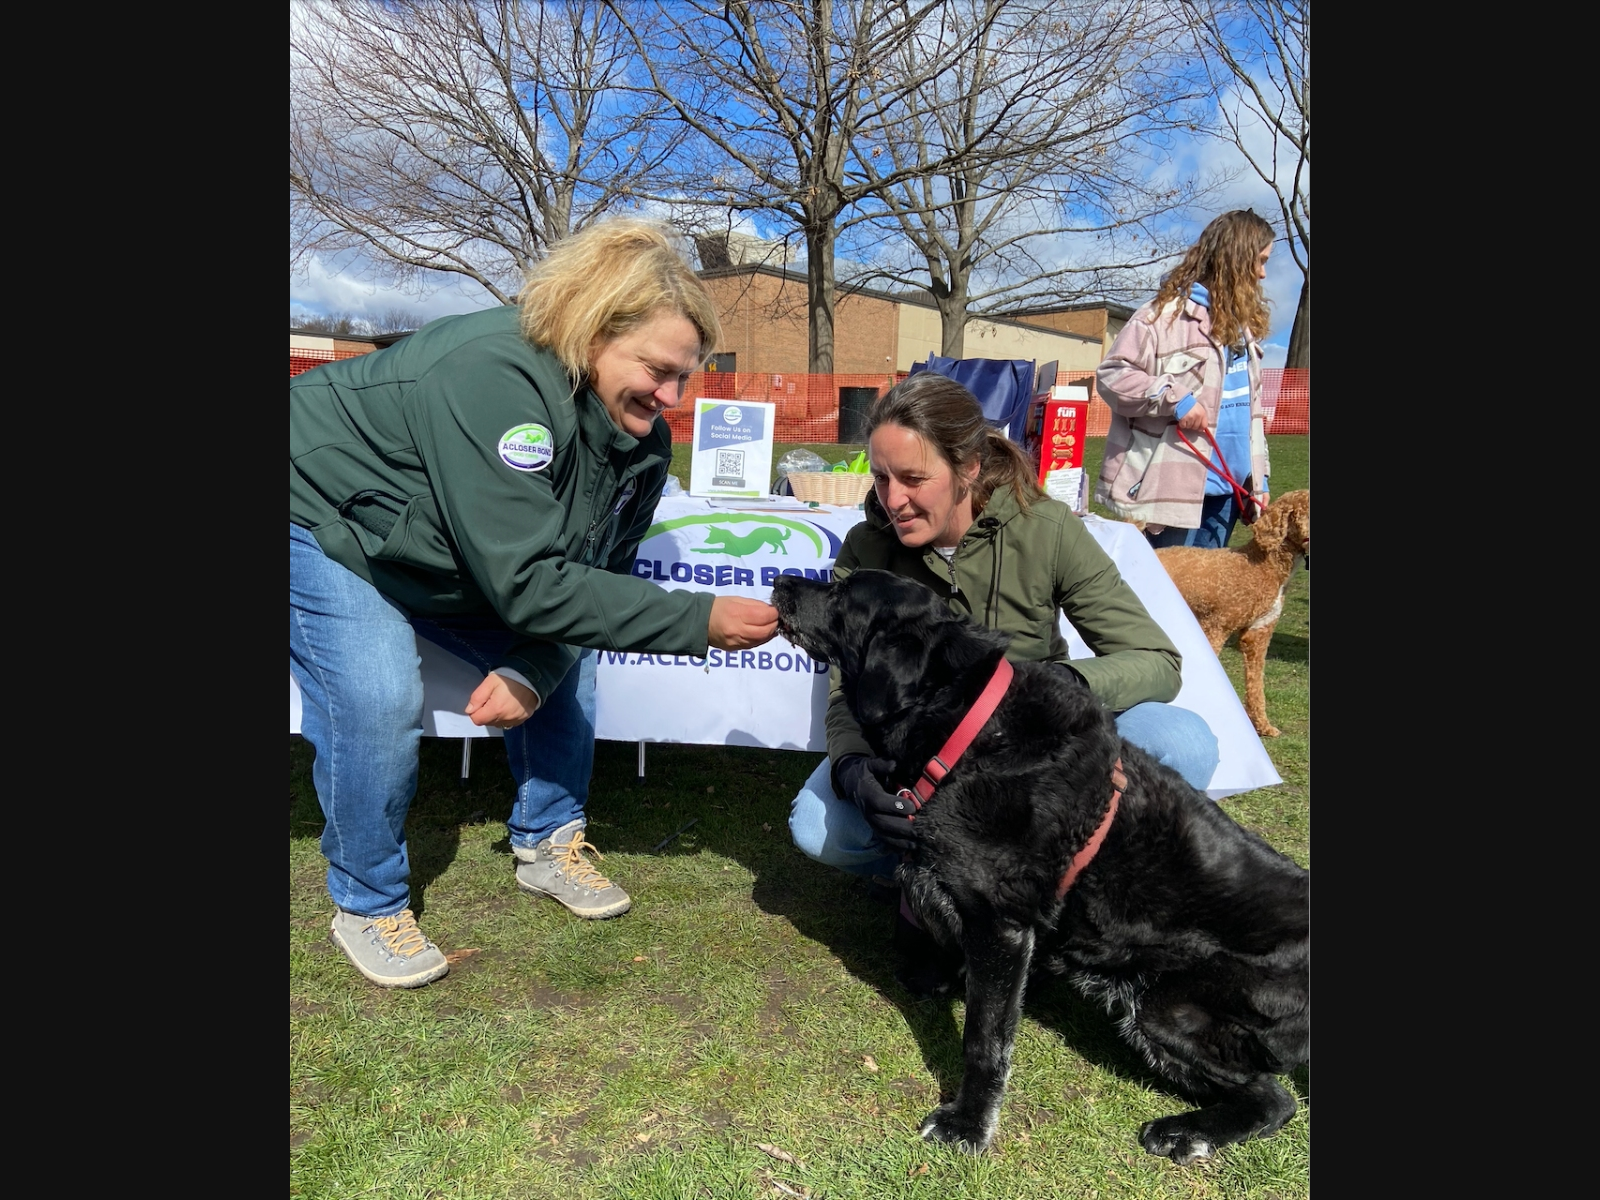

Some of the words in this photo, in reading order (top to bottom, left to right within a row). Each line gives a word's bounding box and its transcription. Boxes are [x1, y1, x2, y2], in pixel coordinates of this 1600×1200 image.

[1057, 406, 1076, 417] fun
[711, 424, 731, 432] Follow
[509, 444, 537, 453] CLOSER
[632, 559, 754, 586] CLOSER
[760, 566, 833, 586] BN
